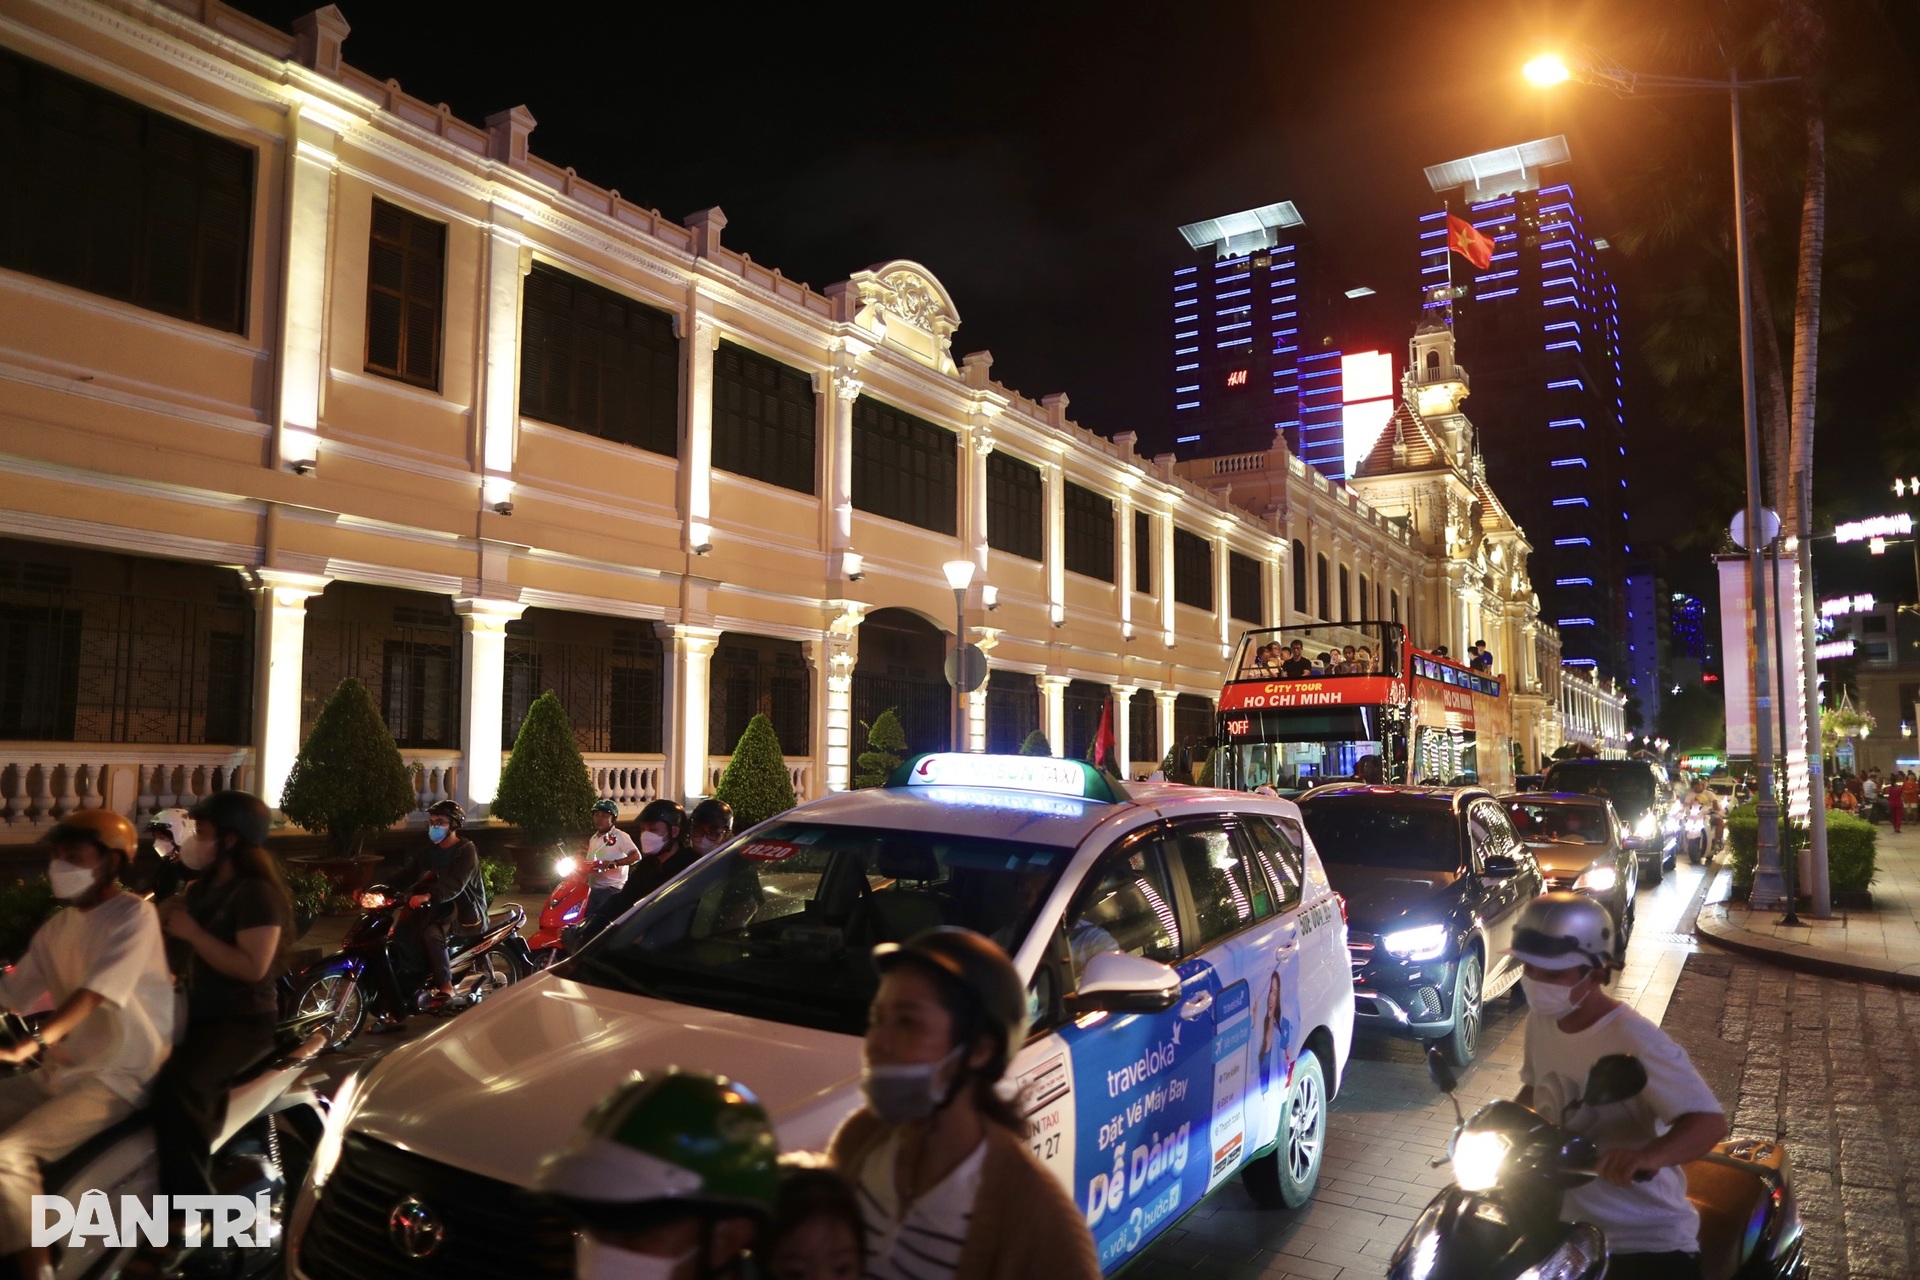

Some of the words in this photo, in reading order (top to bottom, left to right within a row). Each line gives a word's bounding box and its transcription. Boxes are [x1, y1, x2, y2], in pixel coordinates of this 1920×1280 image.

[1244, 696, 1265, 708] HO
[1269, 694, 1296, 706] CHI
[1300, 692, 1342, 705] MINH
[1265, 684, 1292, 694] CITY
[1295, 683, 1323, 692] TOUR
[1443, 689, 1452, 707] HO
[1452, 691, 1460, 708] CHI
[1460, 693, 1473, 711] MINH
[1041, 765, 1077, 785] TAXI
[1107, 1041, 1175, 1099] traveloka
[1041, 1110, 1060, 1131] TAXI
[1099, 1113, 1124, 1151] Đặt
[1126, 1096, 1142, 1129] Vé
[1144, 1086, 1168, 1118] Máy
[1168, 1077, 1189, 1103] Bay
[1045, 1131, 1062, 1160] 27
[1086, 1141, 1127, 1229] Dễ
[1129, 1121, 1191, 1200] Dàng
[1110, 1229, 1128, 1258] với
[1126, 1207, 1143, 1252] 3
[1143, 1197, 1169, 1230] bước
